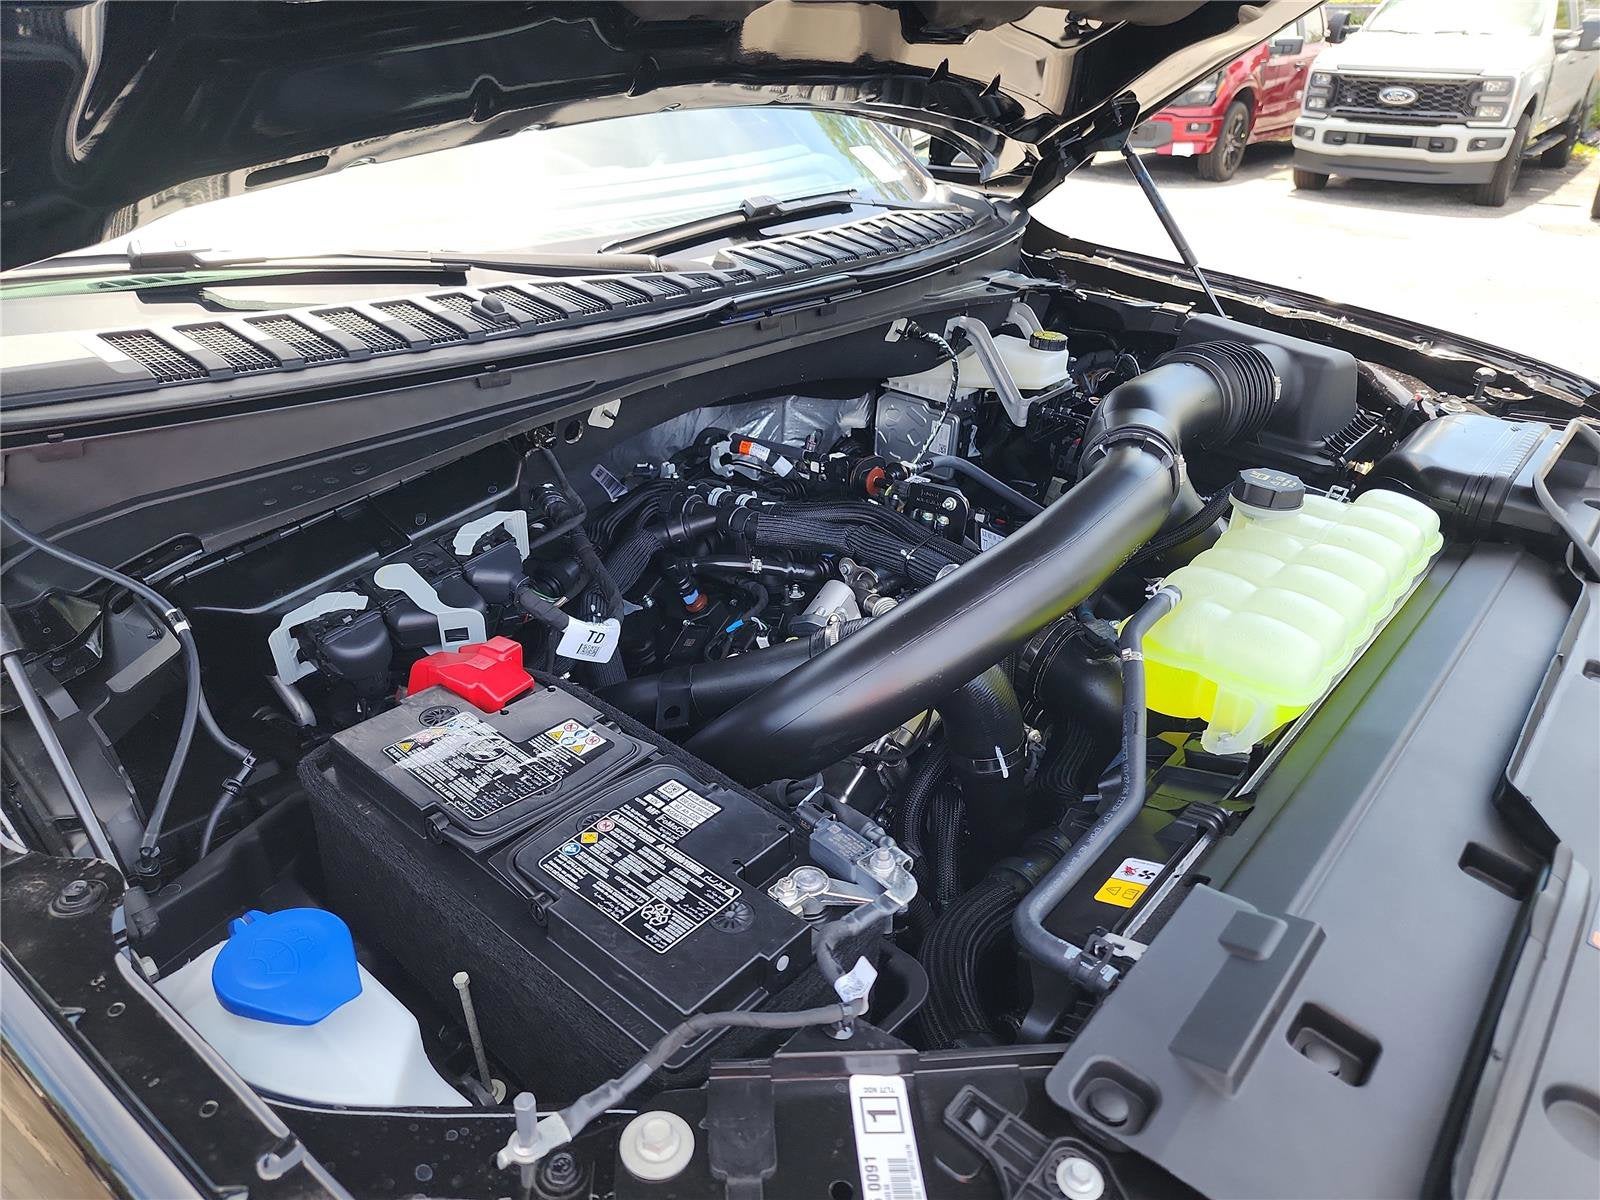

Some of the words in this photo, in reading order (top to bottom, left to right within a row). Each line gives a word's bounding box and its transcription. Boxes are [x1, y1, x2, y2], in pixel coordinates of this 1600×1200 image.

[586, 629, 606, 644] TD
[645, 805, 661, 815] MF
[660, 814, 687, 835] FoMoCo
[866, 1109, 897, 1123] 1
[863, 1156, 882, 1192] 0091
